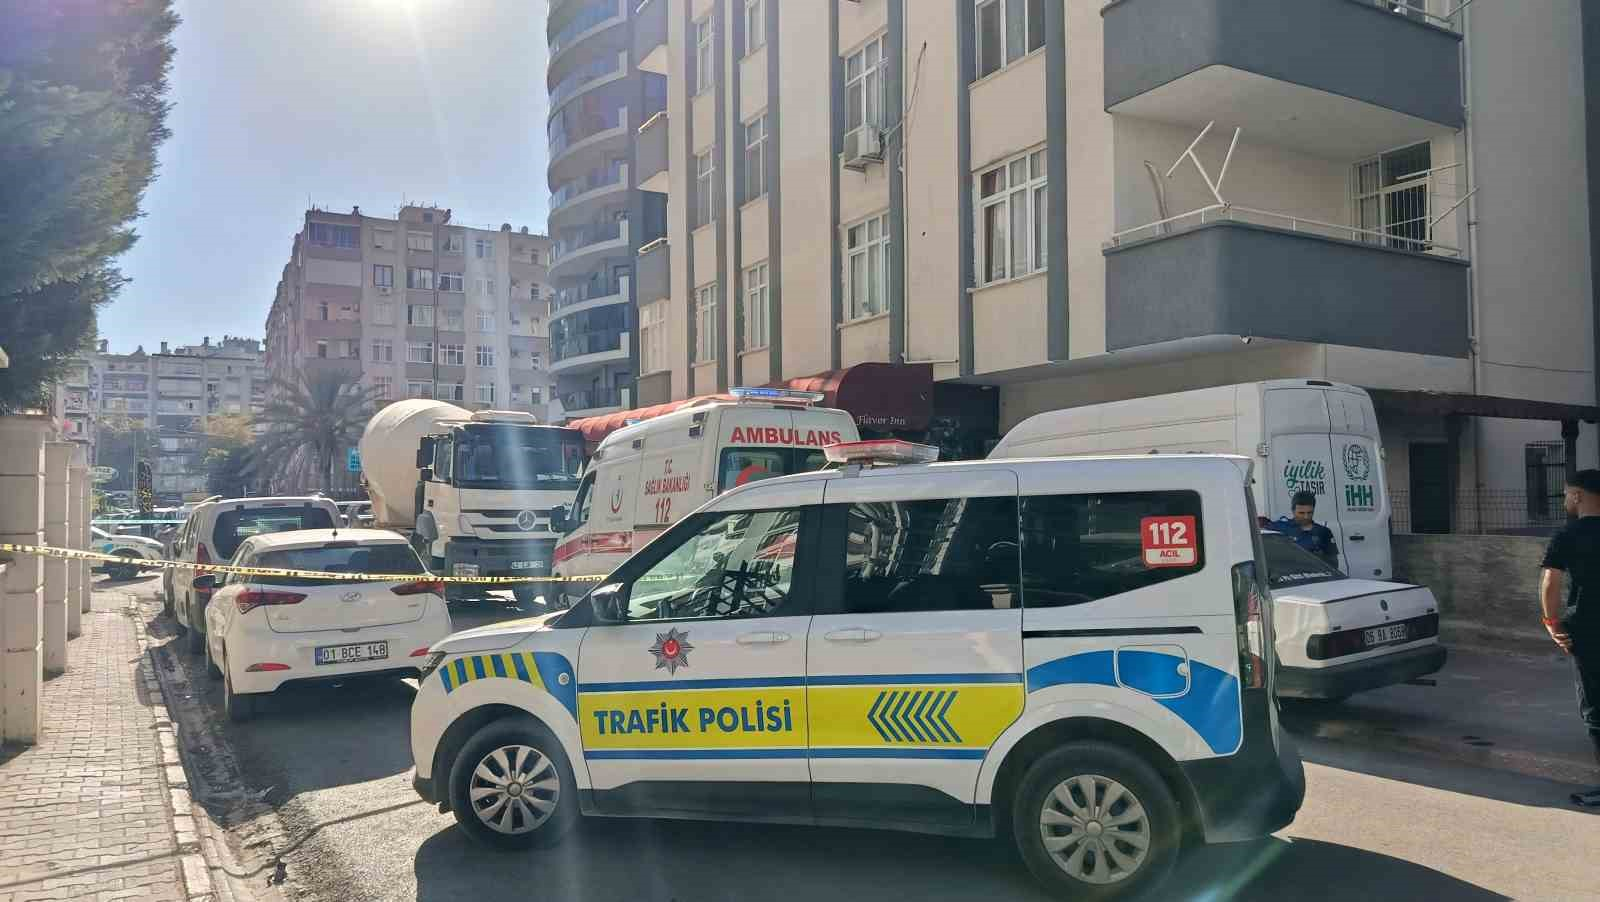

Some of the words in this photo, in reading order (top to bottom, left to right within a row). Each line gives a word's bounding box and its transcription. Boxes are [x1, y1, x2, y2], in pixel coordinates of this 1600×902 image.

[730, 426, 841, 446] AMBULANS
[655, 497, 672, 523] 112
[1149, 521, 1188, 545] 112
[323, 648, 336, 660] 01
[341, 647, 361, 658] BCE
[368, 644, 386, 656] 148
[593, 701, 691, 735] TRAFİK
[699, 699, 793, 733] POLİSİ
